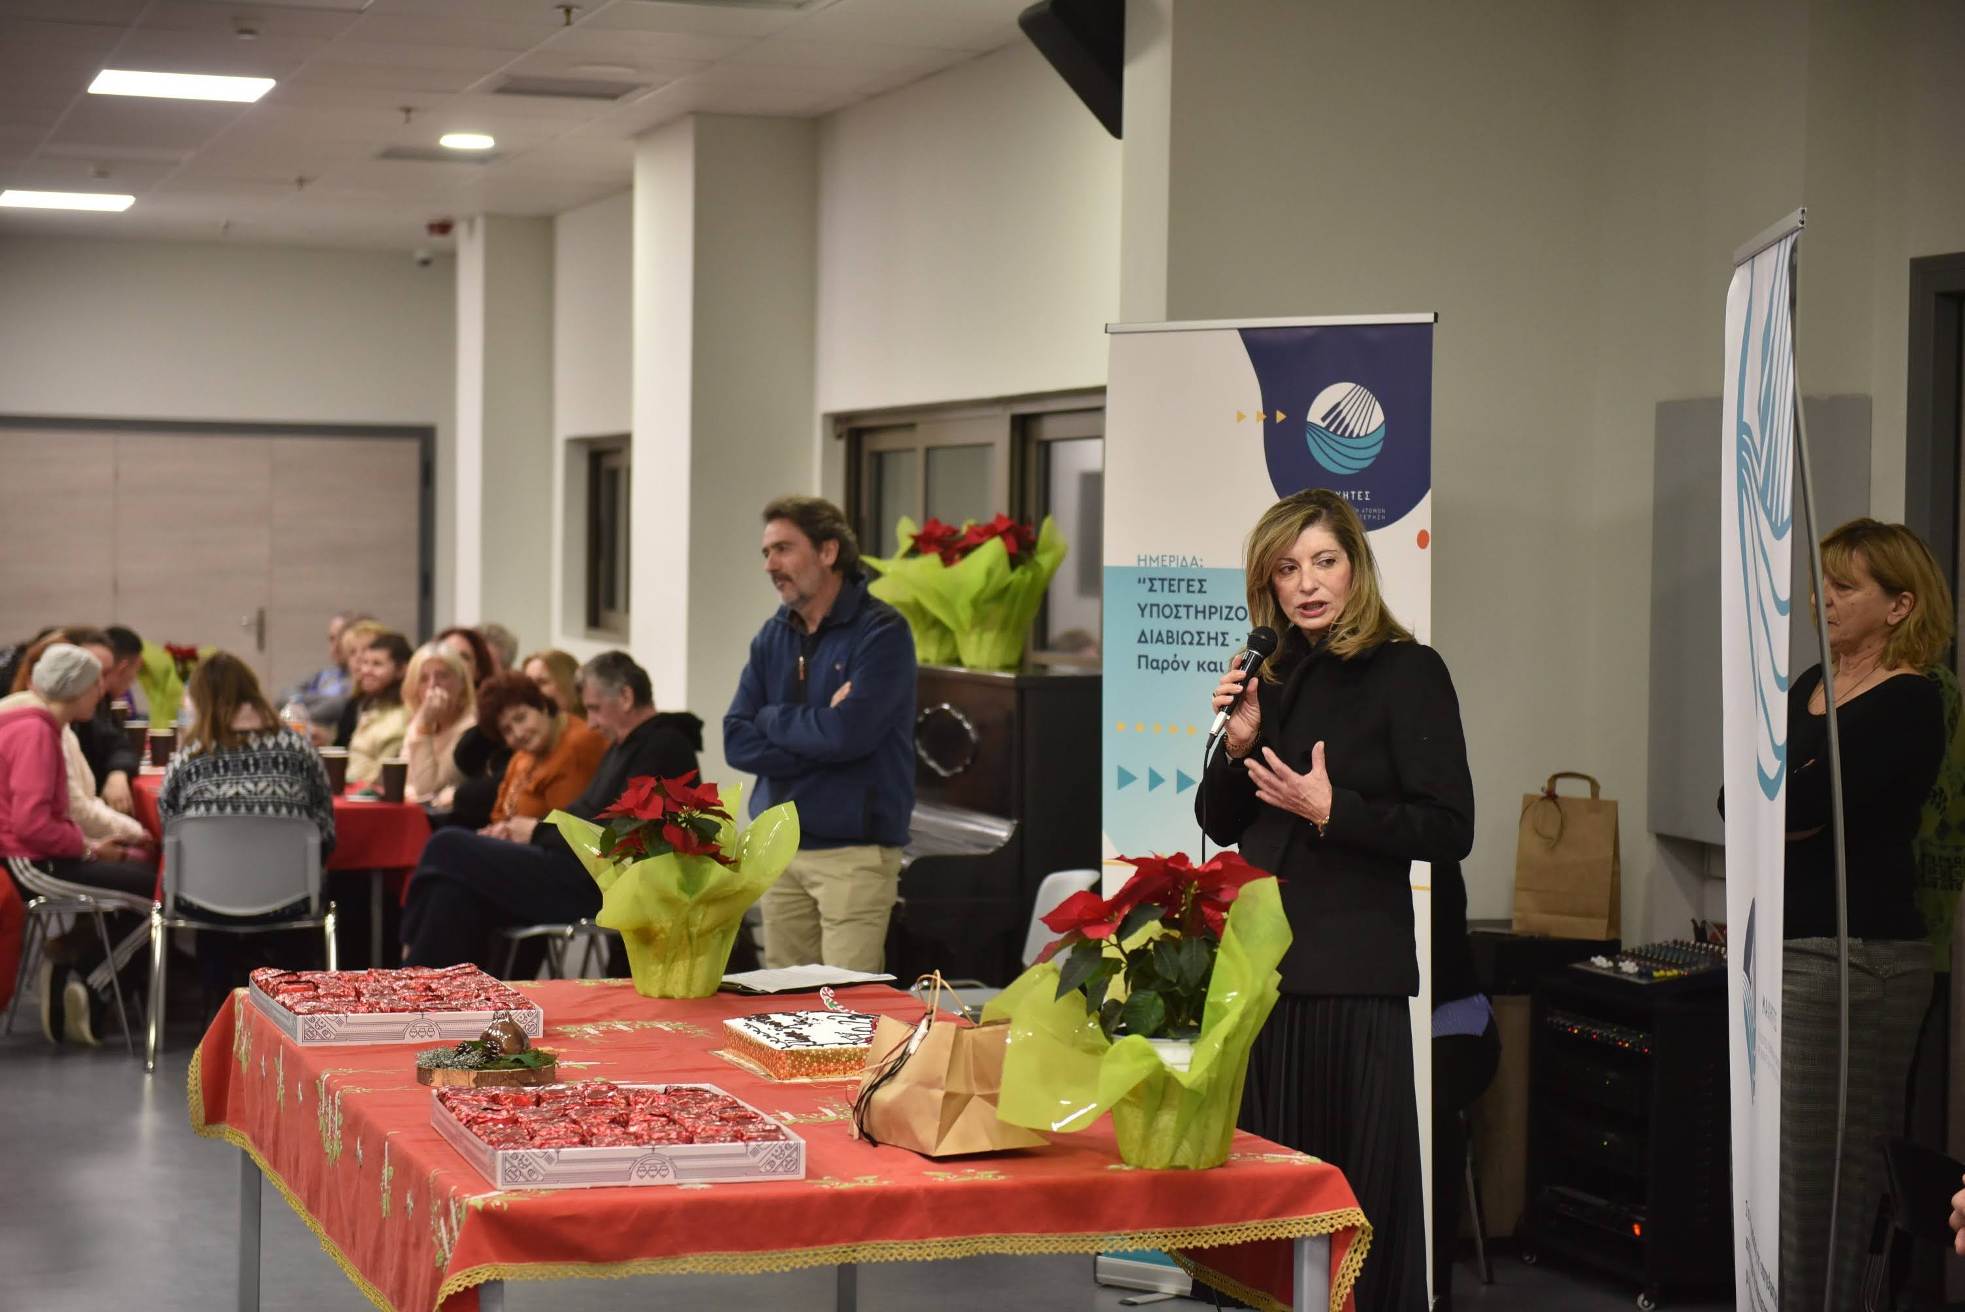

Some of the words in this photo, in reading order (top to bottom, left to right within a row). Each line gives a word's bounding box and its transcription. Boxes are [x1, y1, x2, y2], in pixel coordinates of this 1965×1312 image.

[1136, 554, 1204, 568] ΗΜΕΡΙΔΑ:
[1136, 629, 1230, 647] ΔΙΑΒΙΩΣΗΣ
[1136, 653, 1190, 674] Παρόν
[1196, 660, 1225, 673] και
